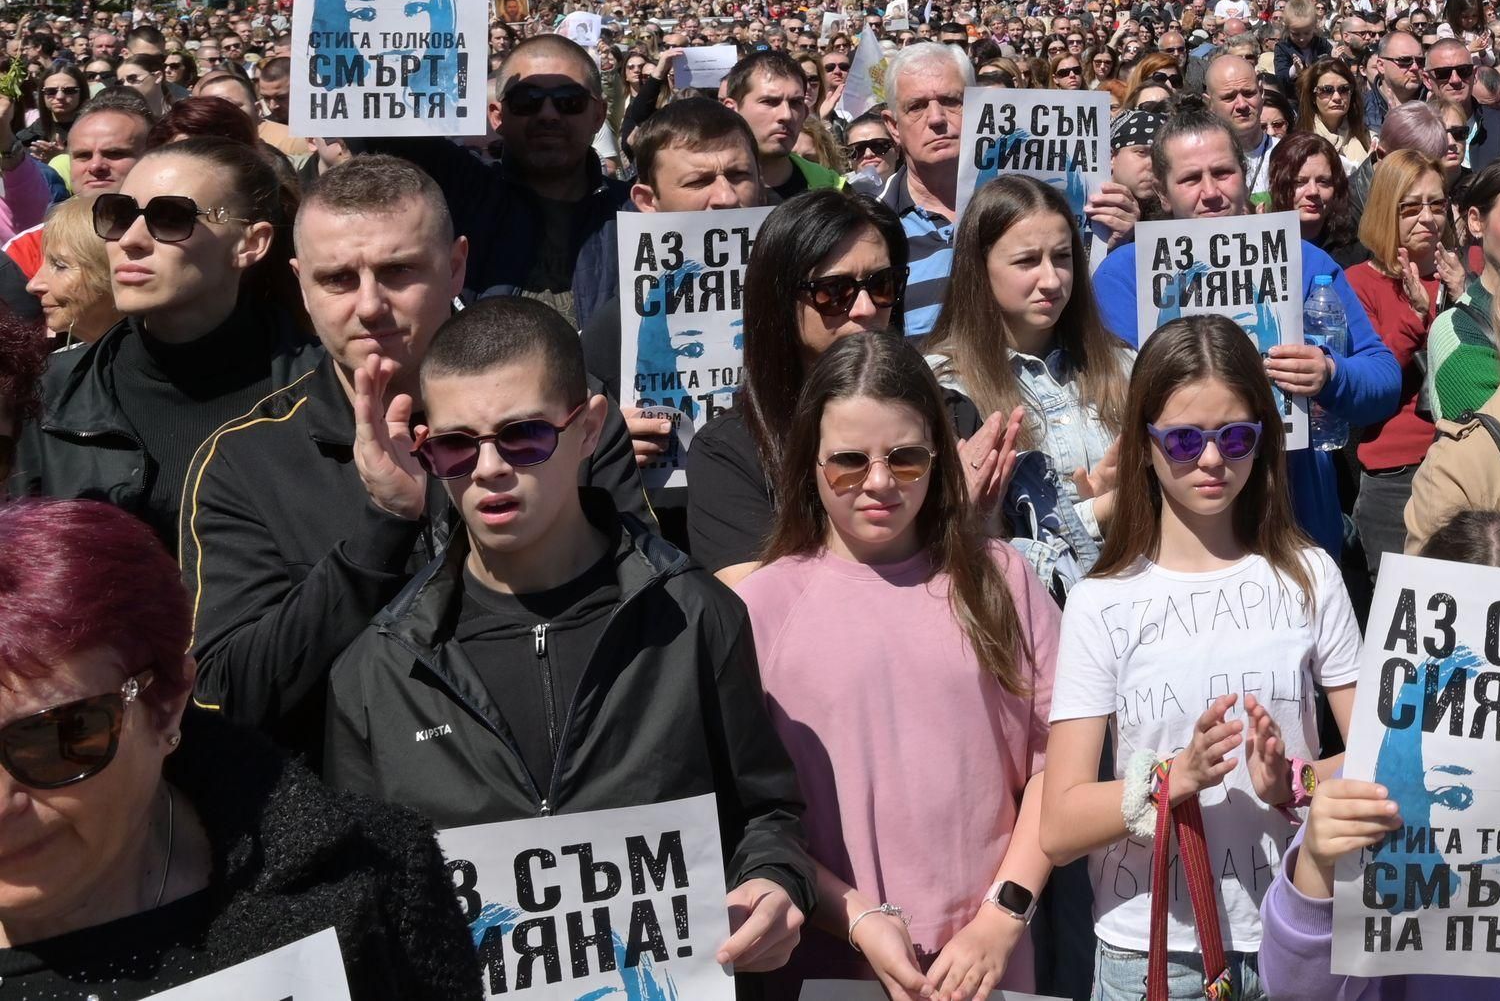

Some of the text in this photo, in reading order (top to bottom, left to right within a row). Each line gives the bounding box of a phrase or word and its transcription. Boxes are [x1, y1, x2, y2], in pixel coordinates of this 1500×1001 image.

[308, 31, 466, 49] СТИГА ТОЛКОВА
[308, 54, 446, 88] СМЪРТ
[310, 93, 349, 119] НА
[976, 103, 1099, 137] АЗ СЪМ
[974, 136, 1098, 173] СИЯНА!
[634, 227, 754, 272] АЗ СЪ
[1152, 229, 1289, 271] АЗ СЪМ
[634, 269, 744, 318] СИЯН
[1152, 266, 1289, 310] СИЯНА!
[634, 369, 700, 392] СТИГА
[1384, 587, 1458, 659] АЗ
[1116, 682, 1185, 730] ЯМА
[416, 724, 453, 742] KIPSTA
[513, 830, 690, 912] СЪМ
[477, 894, 693, 996] ИЯНА!
[1364, 916, 1424, 953] НА
